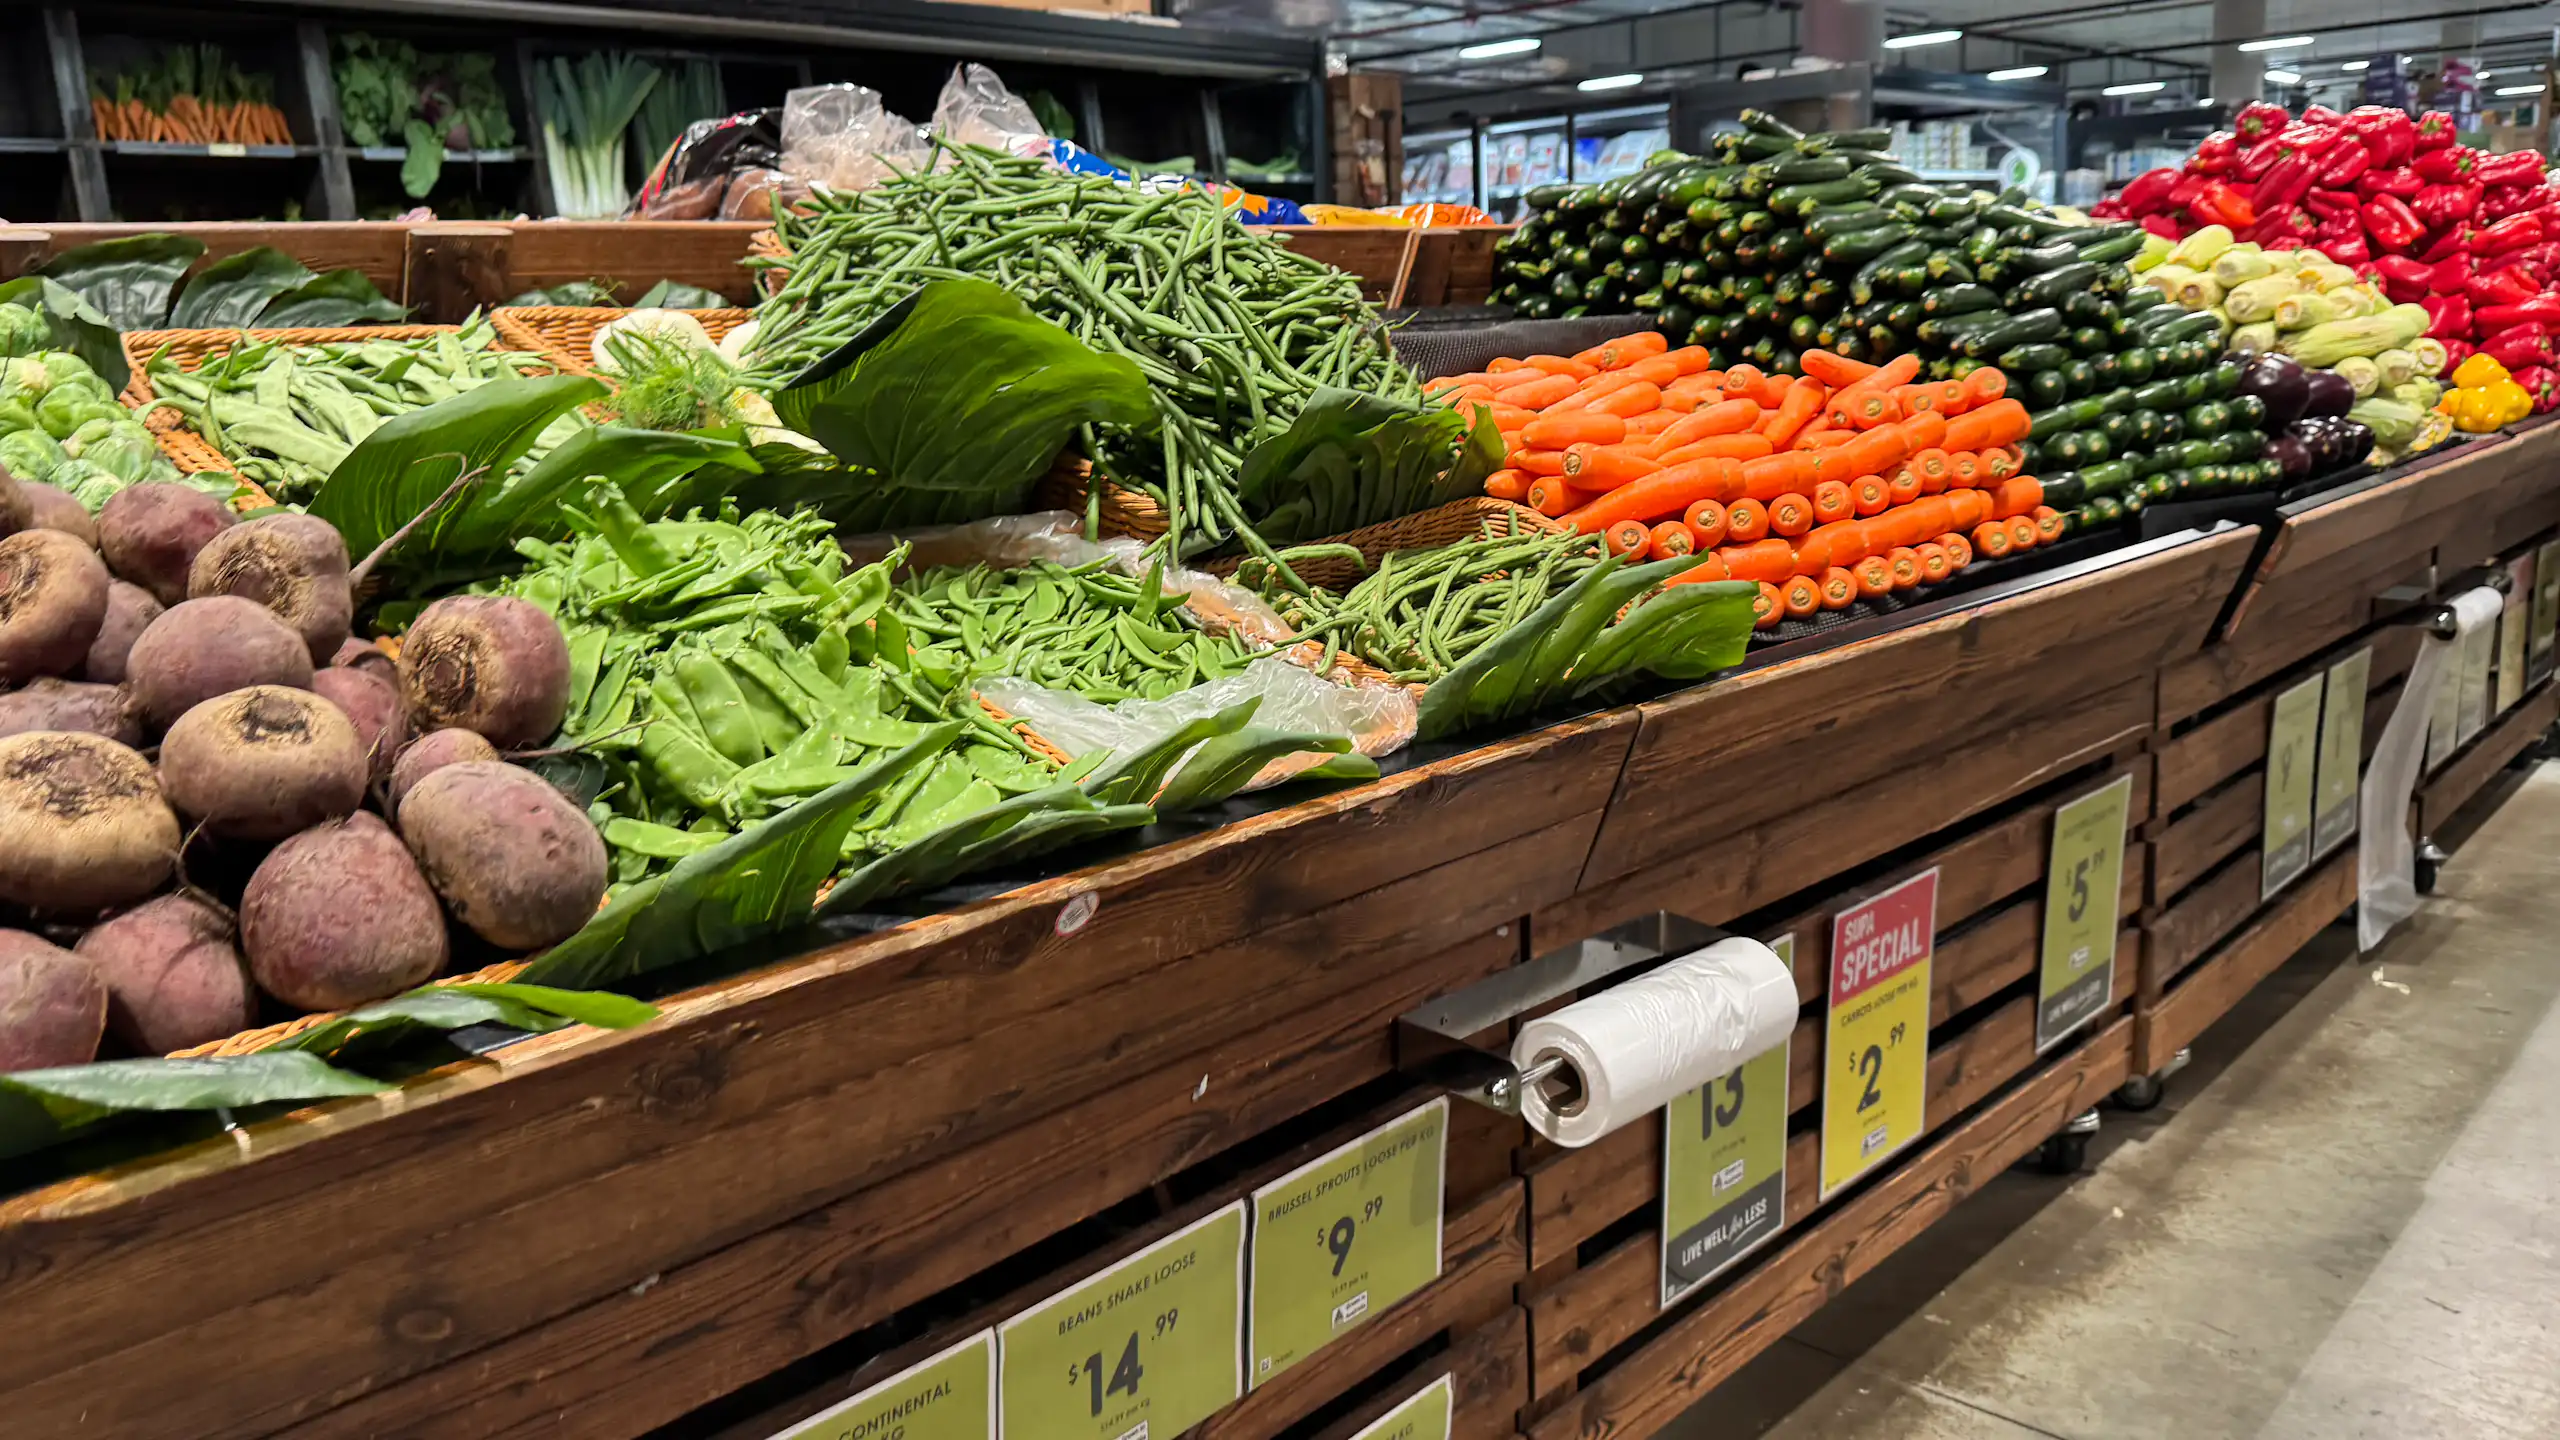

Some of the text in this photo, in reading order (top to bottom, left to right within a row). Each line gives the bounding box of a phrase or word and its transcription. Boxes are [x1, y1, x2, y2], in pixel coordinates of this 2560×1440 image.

[1841, 916, 1922, 993] SPECIAL
[1844, 909, 1875, 948] SUPA
[1268, 1189, 1312, 1223] BRUSSEL
[1315, 1164, 1361, 1198] SPROUTS
[1363, 1147, 1397, 1173] LOOSE
[1399, 1133, 1417, 1154] PER
[1682, 1240, 1702, 1268] LIVE
[1703, 1223, 1728, 1252] WELL
[1744, 1197, 1768, 1226] LESS
[1058, 1251, 1197, 1336] BEANS SNAKE LOOSE
[838, 1379, 952, 1440] CONTINENTAL
